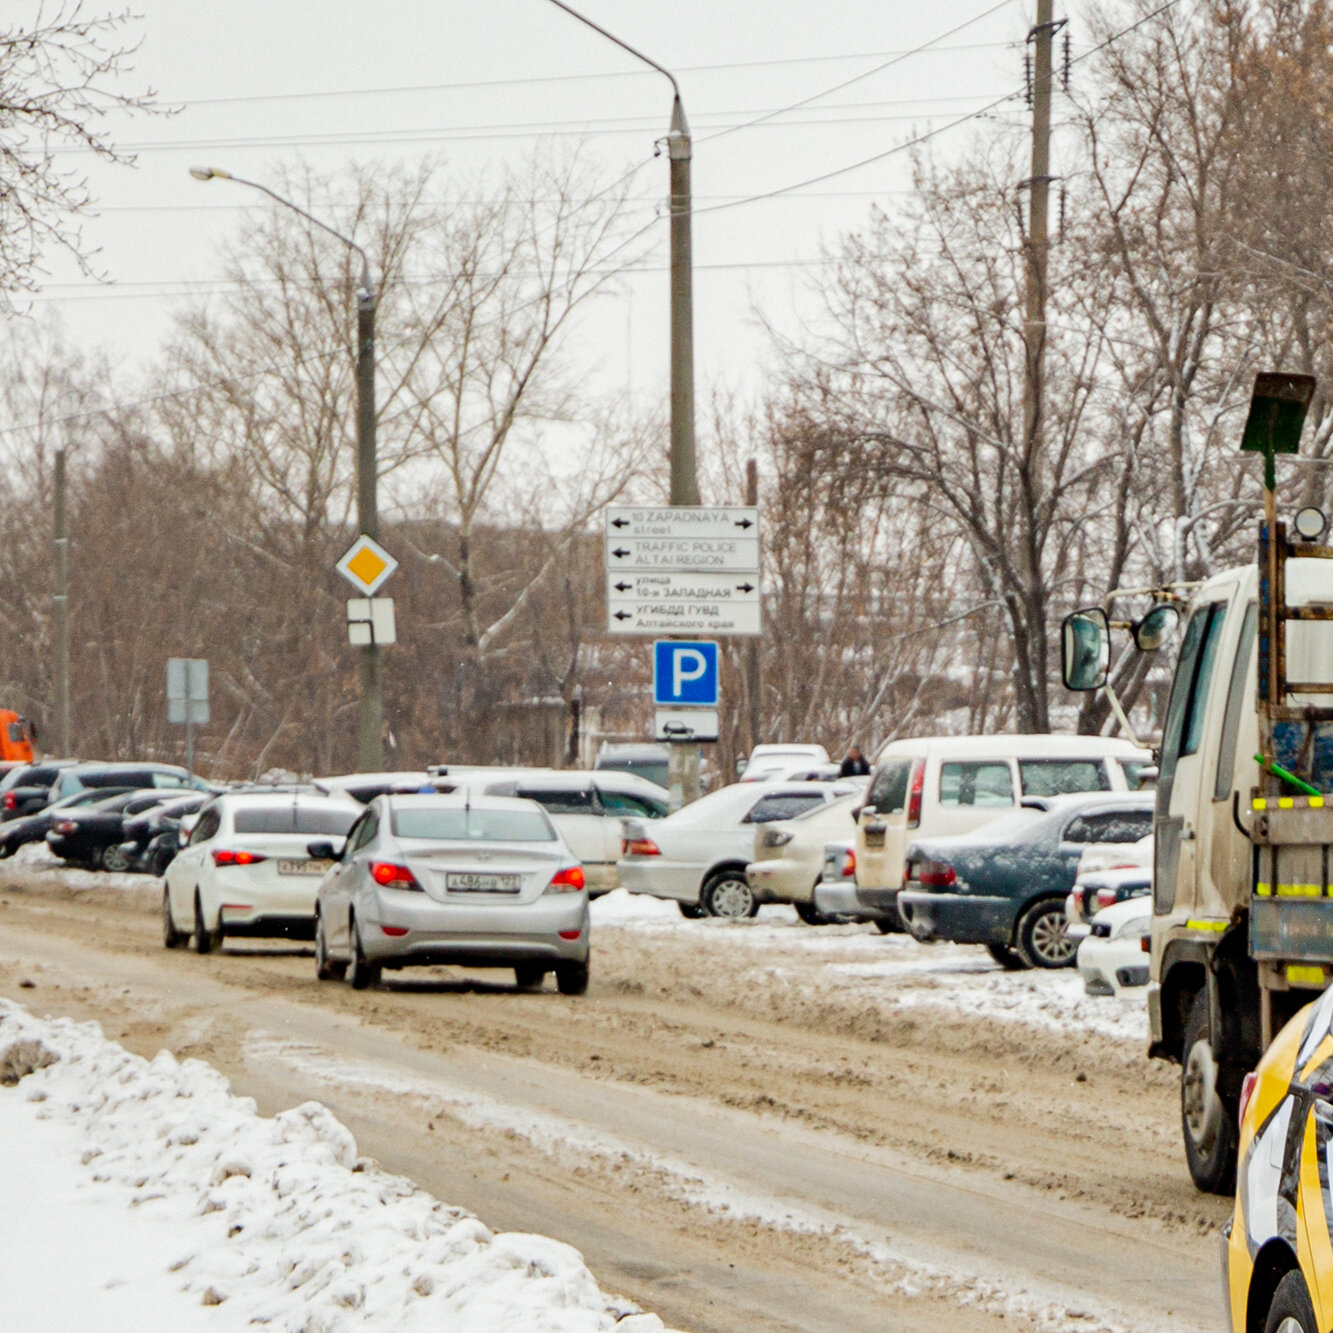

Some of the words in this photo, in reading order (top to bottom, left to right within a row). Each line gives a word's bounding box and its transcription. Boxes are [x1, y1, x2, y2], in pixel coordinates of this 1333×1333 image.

[646, 512, 730, 522] ZAPADNAYA
[634, 525, 672, 534] street
[635, 541, 688, 552] TRAFFIC
[692, 542, 736, 553] POLICE
[635, 555, 673, 565] ALTAI
[676, 555, 724, 565] REGION
[635, 577, 671, 585] улица
[664, 588, 731, 598] ЗАПАДНАЯ
[636, 605, 684, 616] УГИБДД
[688, 606, 719, 616] ГУВД
[636, 619, 704, 628] Алтайского
